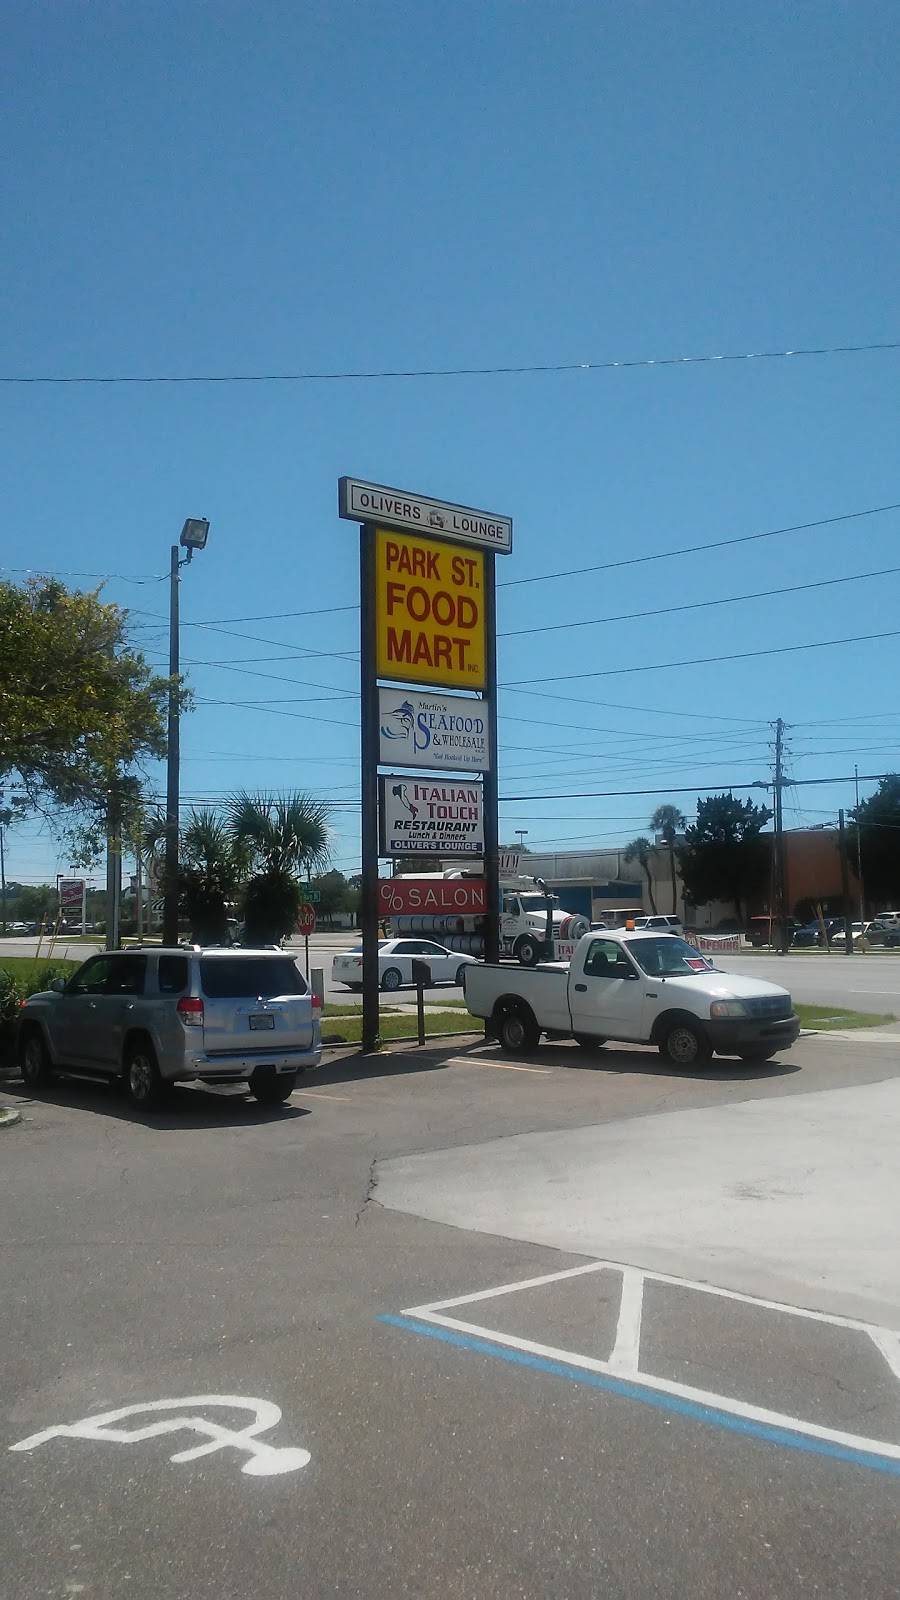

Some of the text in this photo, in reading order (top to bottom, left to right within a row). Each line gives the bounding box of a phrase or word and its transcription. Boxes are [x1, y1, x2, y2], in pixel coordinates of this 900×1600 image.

[360, 493, 503, 539] OLIVERS LOUNGE
[385, 541, 480, 589] PARK ST.
[386, 581, 479, 629] FOOD
[387, 626, 471, 672] MART
[418, 701, 447, 712] Martin's
[413, 712, 484, 754] SEAFOOD
[432, 733, 485, 749] & WHOLESALE
[413, 784, 478, 803] ITALIAN
[426, 802, 479, 820] TOUCH
[394, 820, 478, 832] RESTAURANT
[408, 831, 430, 839] Lunch
[439, 832, 466, 841] Dinners
[394, 840, 478, 851] OLIVER'S LOUNGE
[408, 888, 485, 907] SALON
[298, 913, 314, 926] SOP
